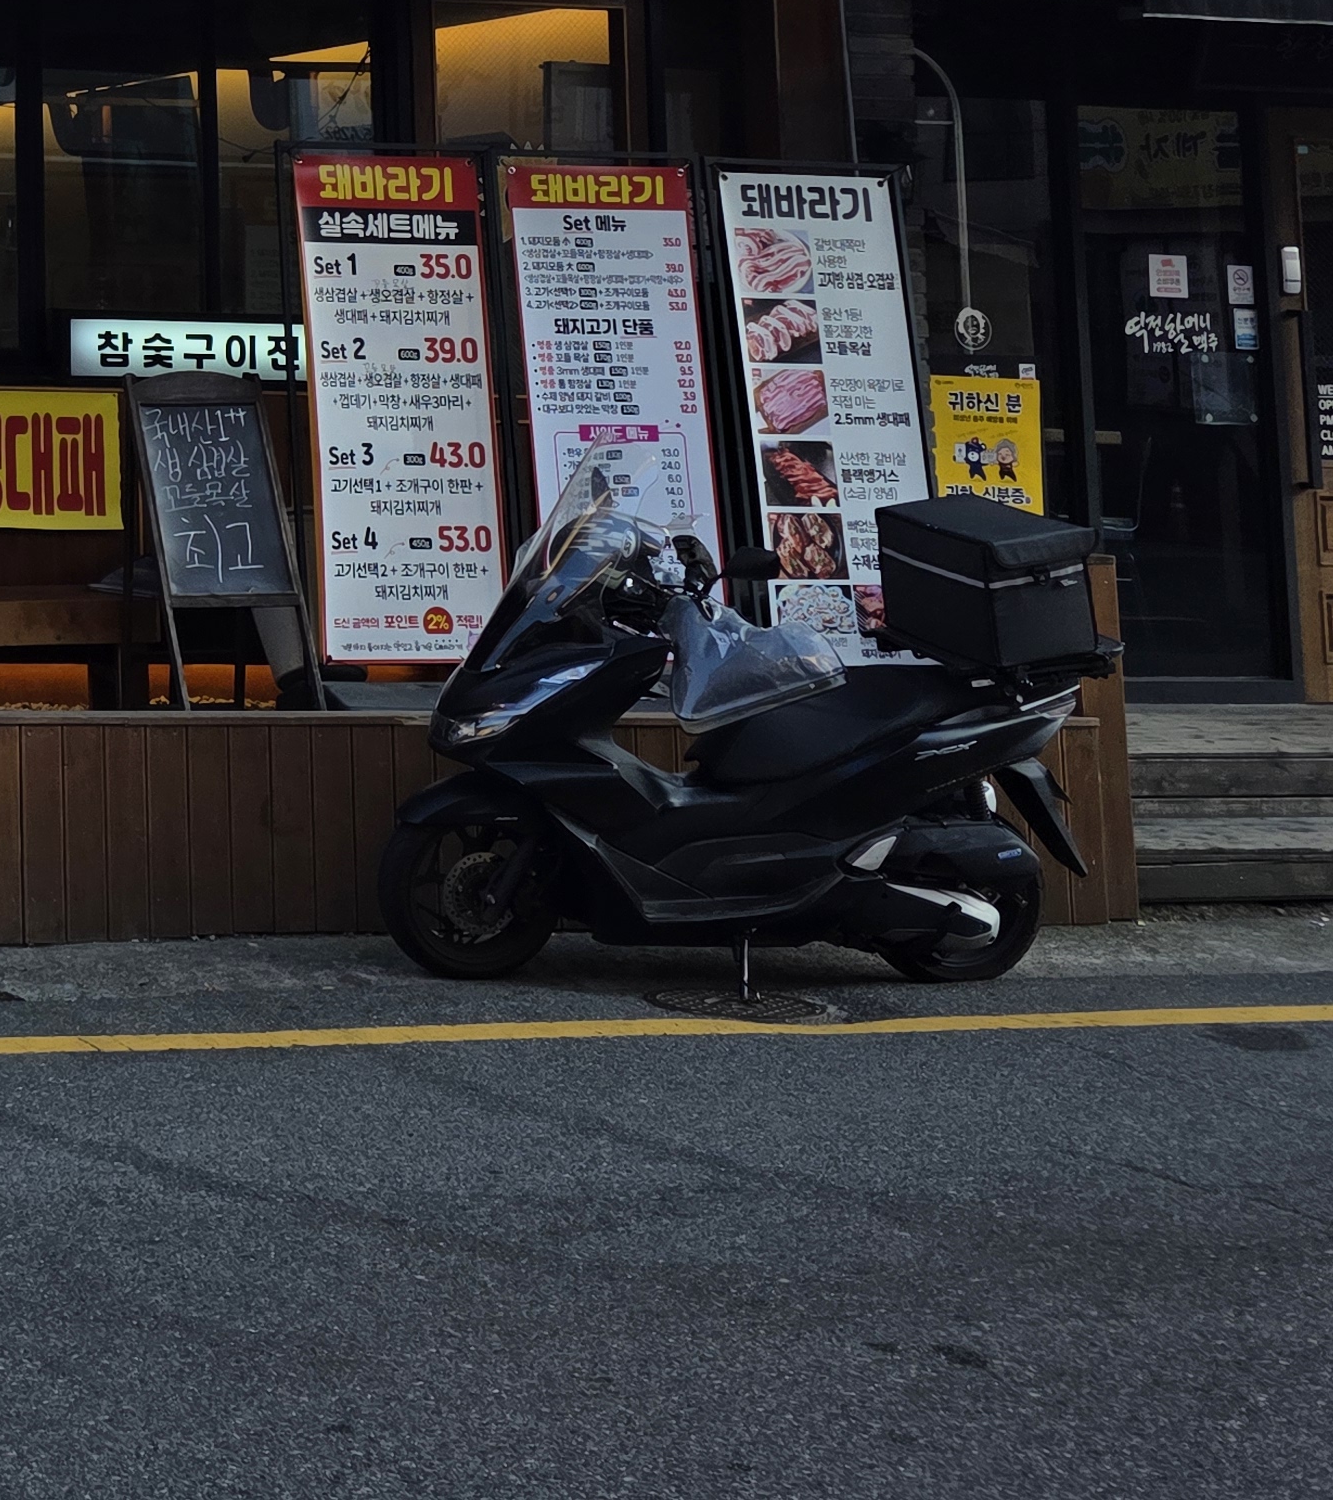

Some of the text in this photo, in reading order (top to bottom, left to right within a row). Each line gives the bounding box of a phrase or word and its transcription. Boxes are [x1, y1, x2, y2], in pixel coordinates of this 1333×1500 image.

[318, 163, 454, 203] 돼바라기
[530, 173, 665, 205] 돼바라기
[741, 183, 873, 223] 돼바라기
[318, 211, 459, 240] 실속세트메뉴
[563, 215, 627, 232] Set 메뉴
[662, 237, 681, 247] 35.0
[314, 252, 472, 280] Set 1 35.0
[665, 263, 684, 274] 39.0
[817, 255, 847, 269] 사용한
[667, 288, 686, 299] 43.0
[668, 301, 688, 312] 53.0
[554, 318, 654, 336] 돼지고기 단품
[1124, 311, 1164, 354] 역전
[673, 341, 691, 350] 12.0
[1192, 331, 1219, 353] 맥주
[321, 337, 479, 364] Set 2 39.0
[675, 353, 693, 363] 12.0
[679, 366, 694, 376] 9.5
[677, 379, 695, 389] 12.0
[682, 391, 696, 401] 3.9
[948, 391, 1022, 413] 귀하신 분
[679, 404, 697, 414] 12.0
[366, 415, 434, 432] 돼지김치찌개
[833, 413, 875, 425] 2.5mm
[328, 441, 485, 468] Set 3 43.0
[661, 448, 680, 458] 13.0
[839, 451, 907, 466] 신선한 갈비살
[661, 461, 681, 470] 24.0
[667, 474, 682, 483] 6.0
[841, 468, 900, 484] 블랙앵거스
[330, 478, 473, 495] 고기선택1 조개구이 한판
[665, 487, 683, 496] 14.0
[370, 500, 442, 516] 돼지김치찌개
[670, 499, 685, 509] 5.0
[331, 525, 492, 553] Set 4 53.0
[173, 514, 264, 584] 최고
[334, 562, 478, 580] 고기선택2 조개구이 한판
[375, 584, 449, 601] 돼지김치찌개
[384, 615, 420, 628] 포인트
[426, 614, 450, 631] 2%
